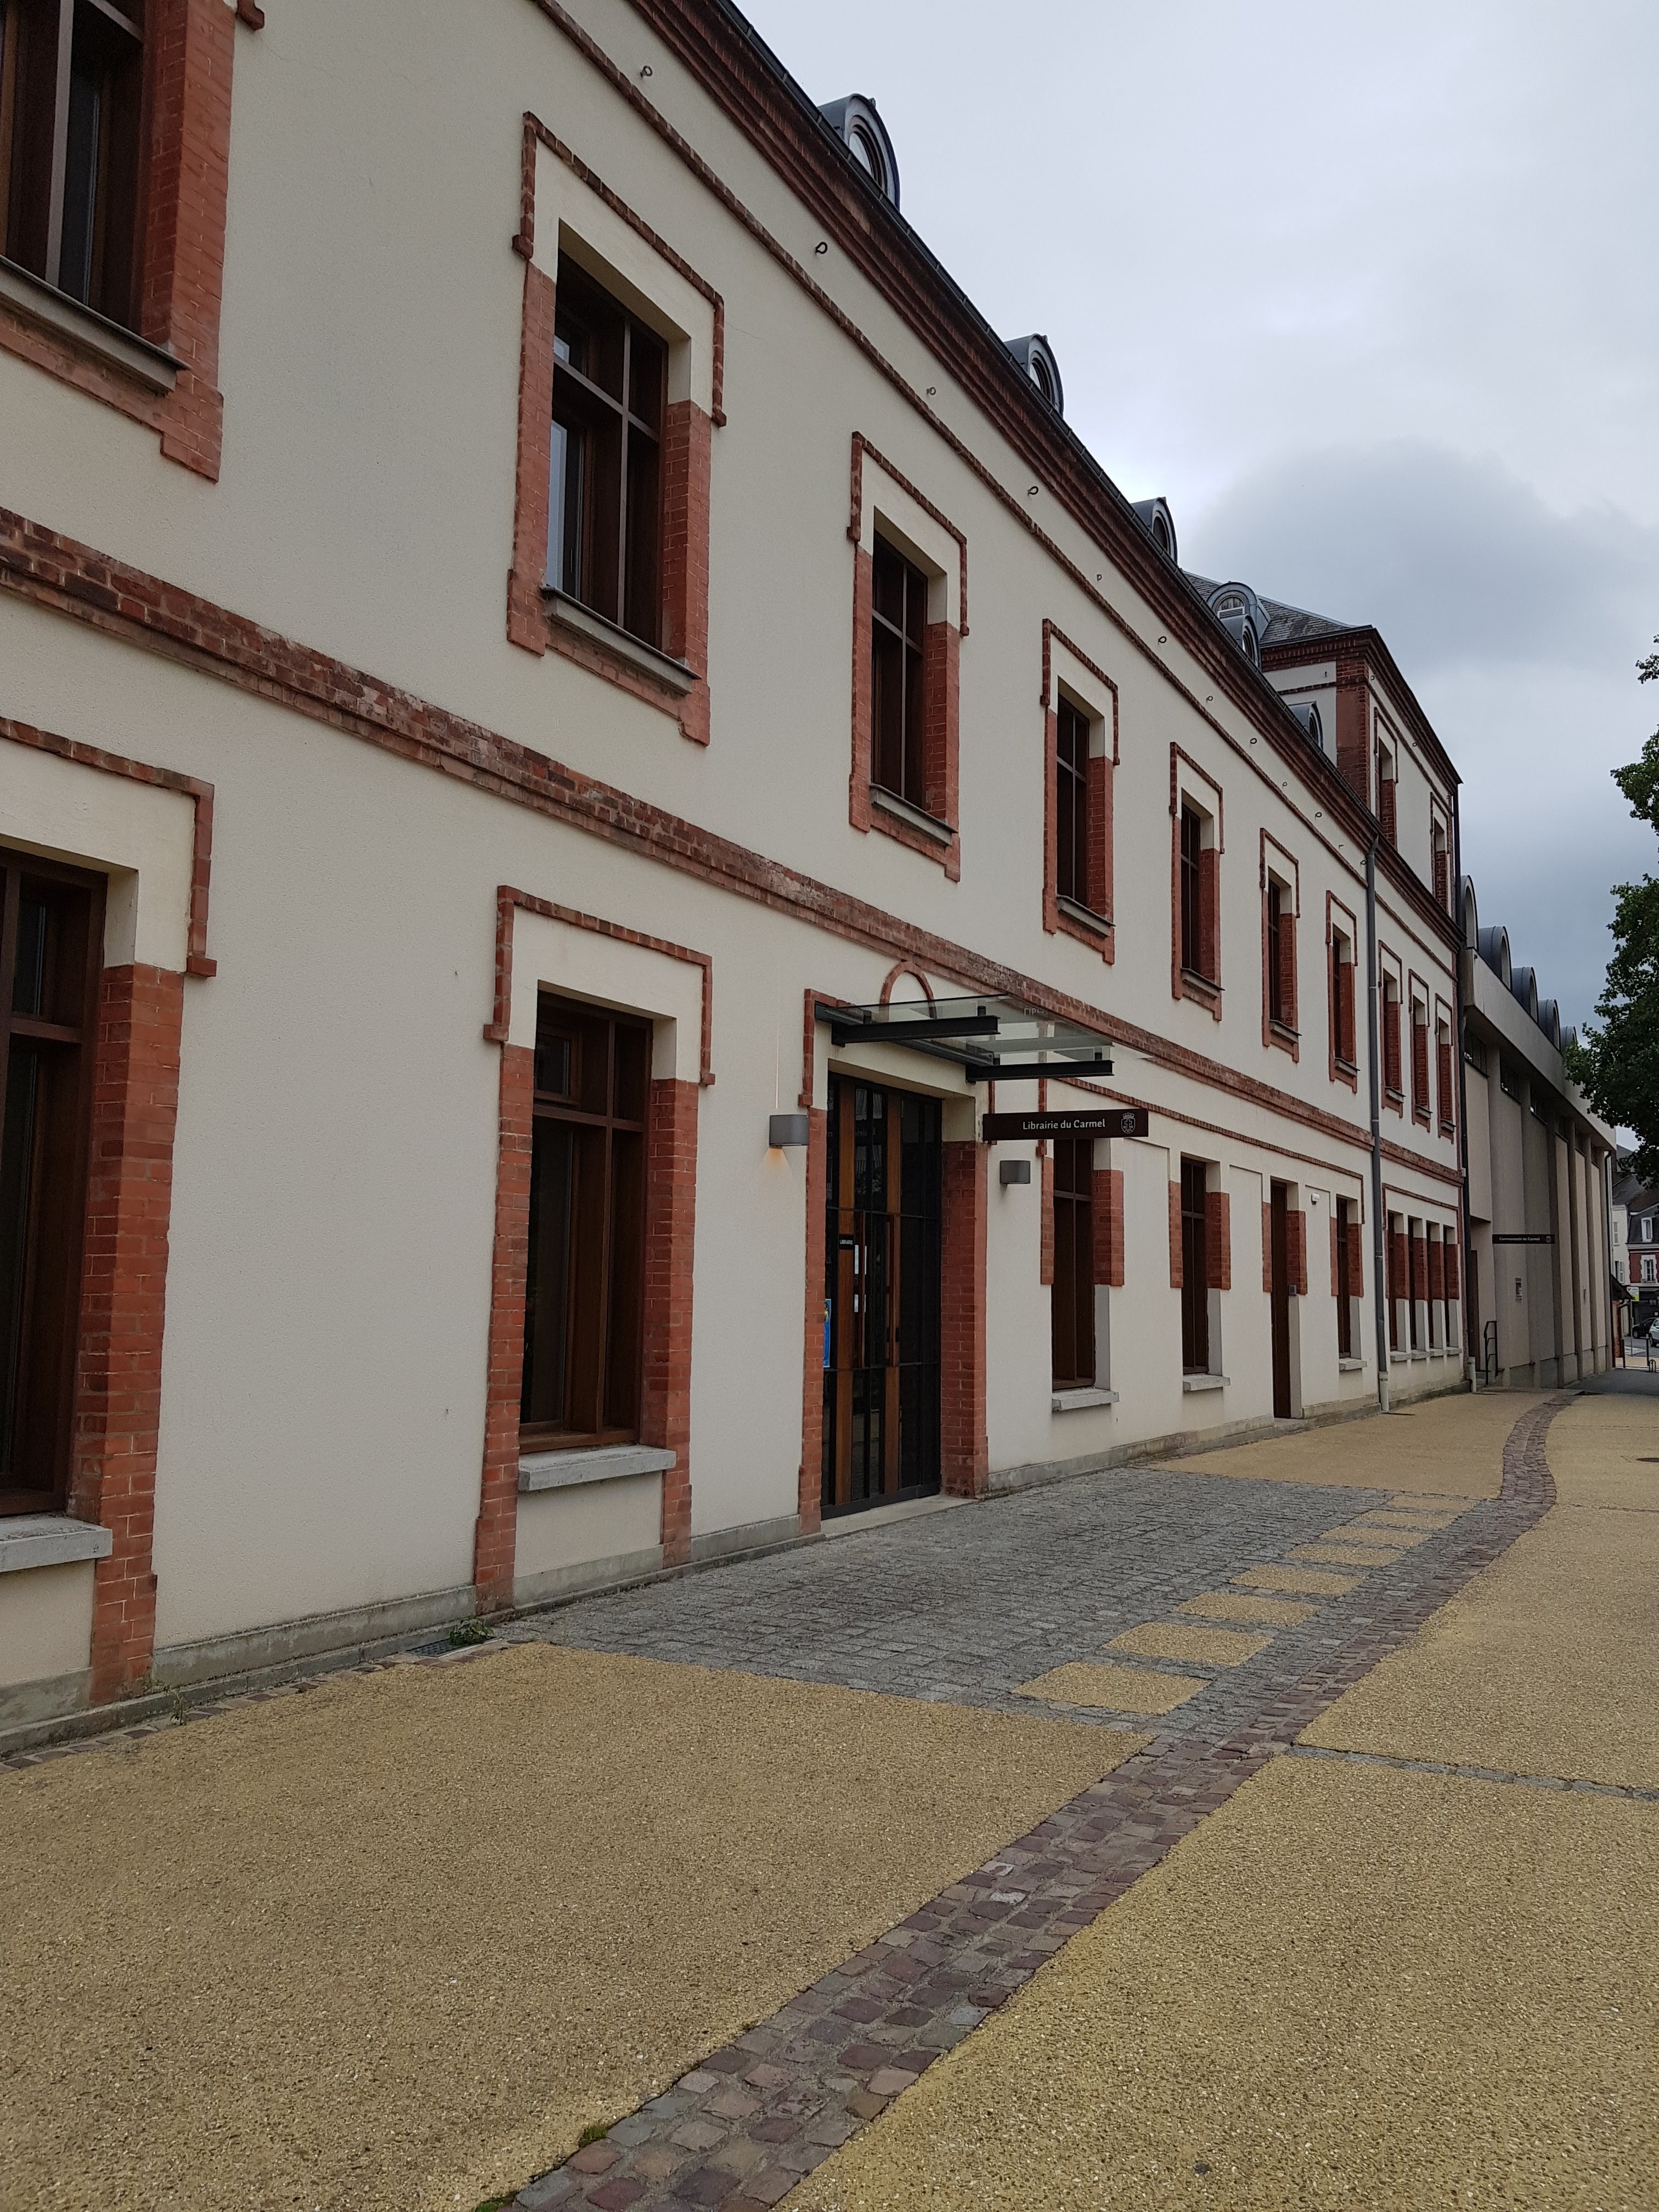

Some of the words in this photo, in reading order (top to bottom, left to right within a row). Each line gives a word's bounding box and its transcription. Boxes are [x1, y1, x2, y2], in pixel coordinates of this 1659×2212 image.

[1023, 1121, 1058, 1130] Librairie
[1060, 1120, 1071, 1128] du
[1073, 1118, 1105, 1128] Carmel
